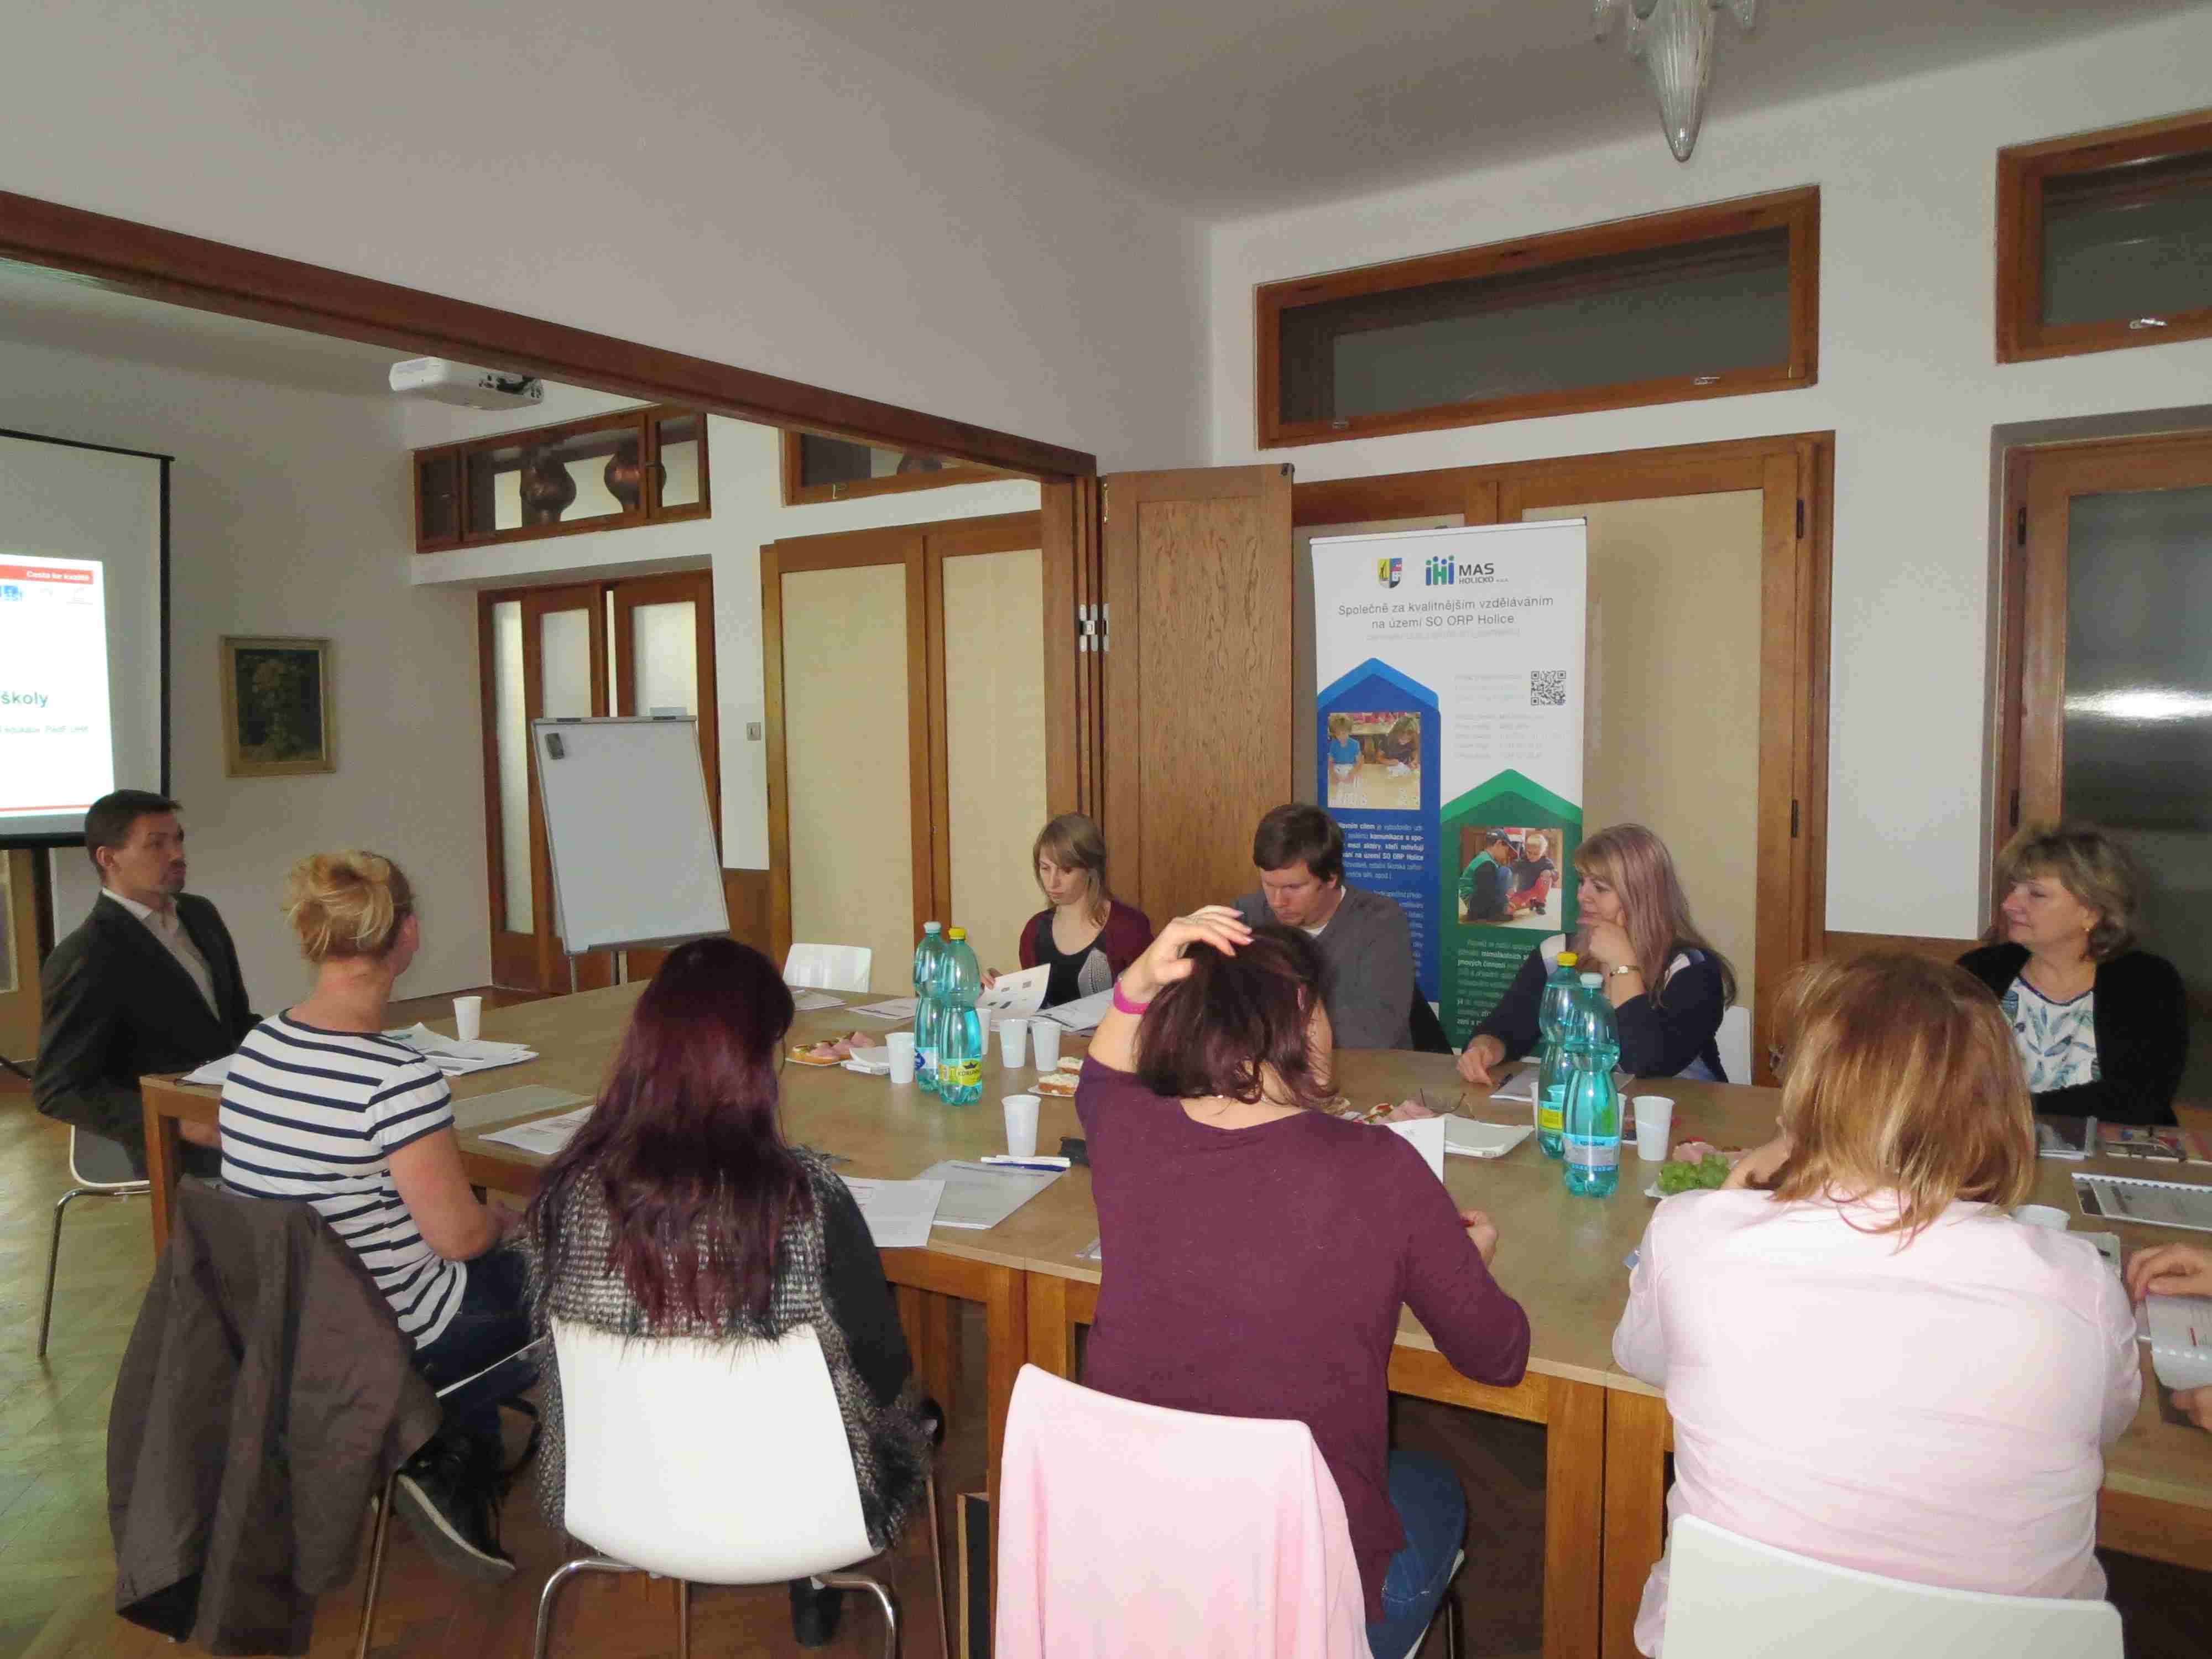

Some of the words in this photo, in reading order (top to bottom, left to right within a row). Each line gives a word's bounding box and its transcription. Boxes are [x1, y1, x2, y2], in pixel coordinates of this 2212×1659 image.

[1459, 563, 1494, 576] MAS
[1338, 602, 1389, 618] Společně
[1392, 604, 1405, 613] za
[1408, 598, 1475, 613] kvalitnějším
[1479, 594, 1553, 609] vzděláváním
[1371, 620, 1385, 629] na
[1389, 617, 1422, 628] území
[1425, 615, 1443, 627] SO
[1447, 614, 1474, 626] ORP
[1477, 613, 1515, 624] Holice
[1, 691, 49, 708] školy
